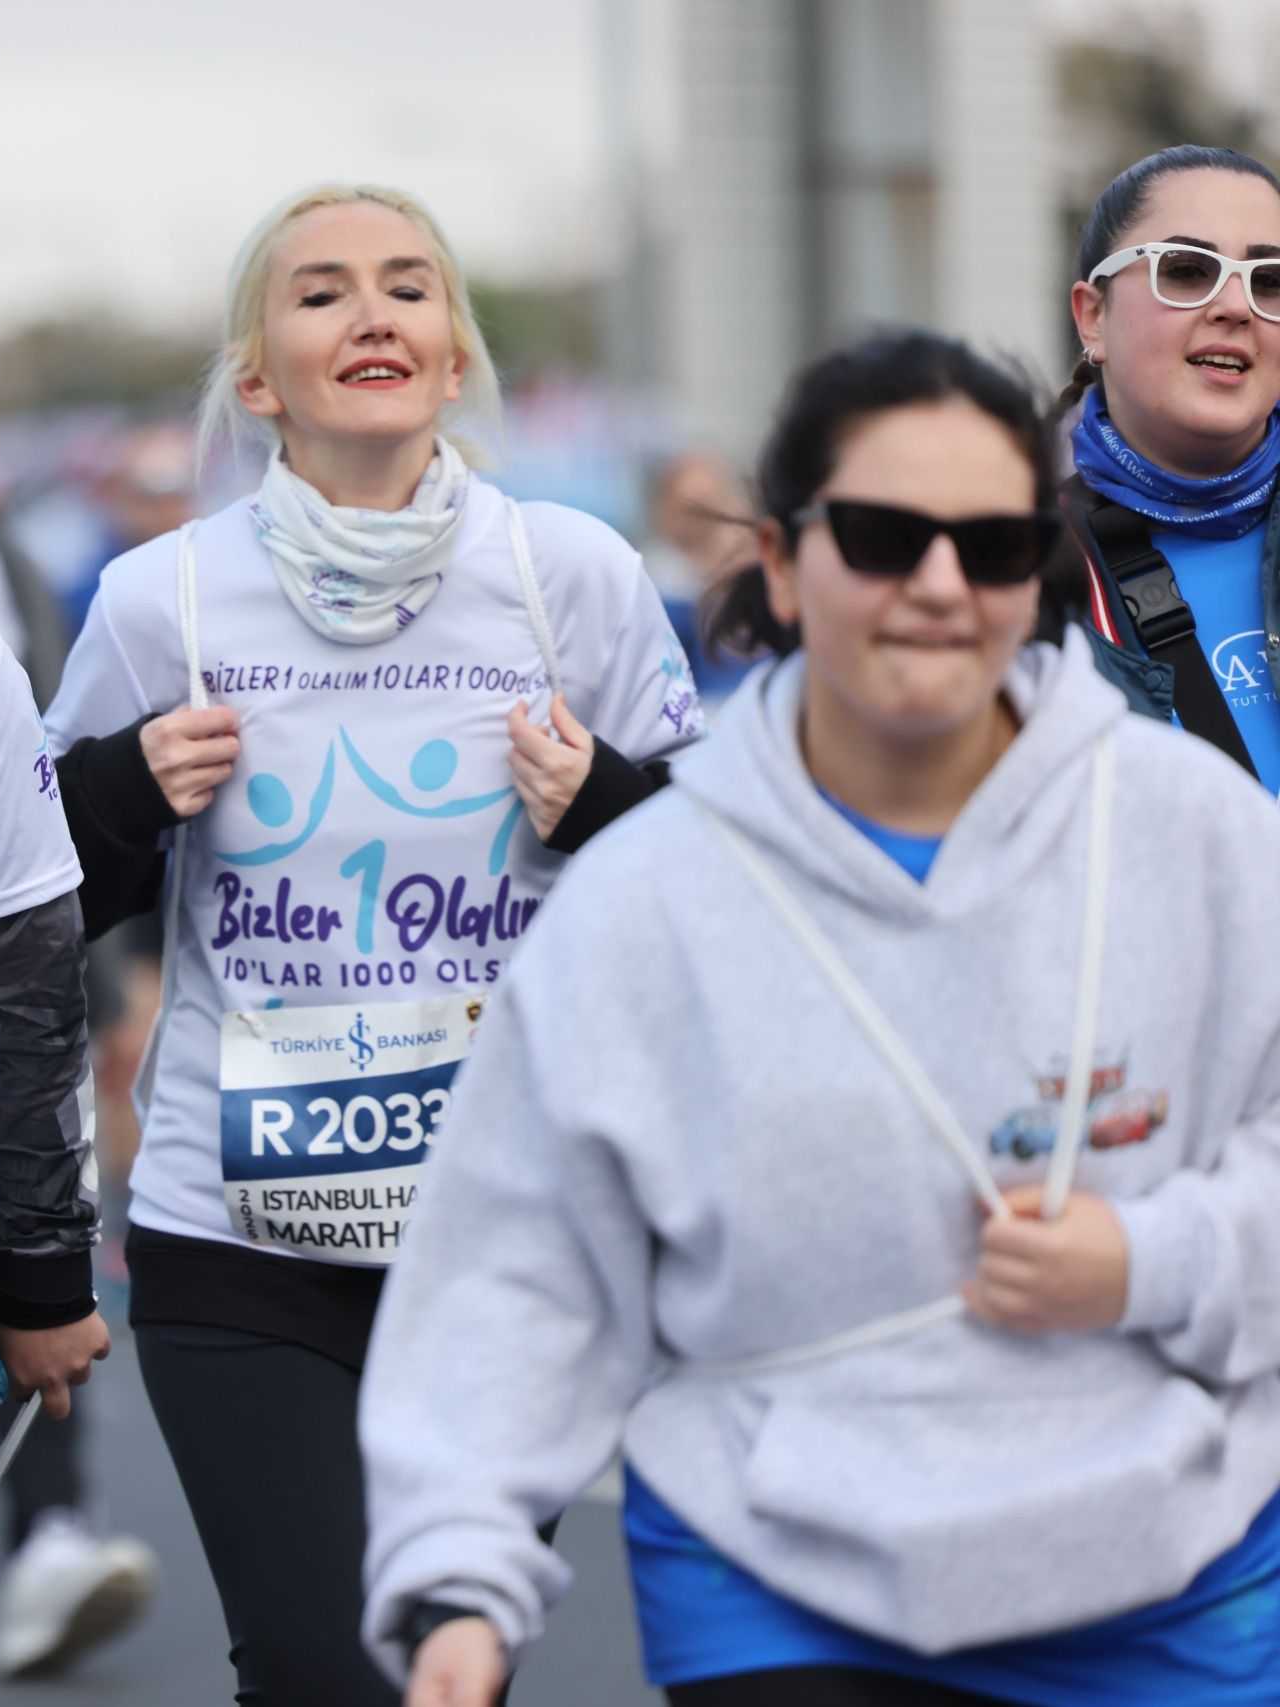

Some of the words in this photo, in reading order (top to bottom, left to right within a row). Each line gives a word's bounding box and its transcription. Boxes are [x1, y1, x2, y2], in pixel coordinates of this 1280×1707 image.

[212, 870, 343, 950] Bizler
[340, 838, 387, 954] 1
[436, 958, 502, 983] OLS
[270, 1036, 345, 1055] TÜRKİYE
[376, 1028, 448, 1049] BANKASI
[250, 1099, 295, 1157] R
[262, 1187, 382, 1213] ISTANBUL
[385, 1184, 418, 1209] HA
[265, 1219, 407, 1249] MARATH
